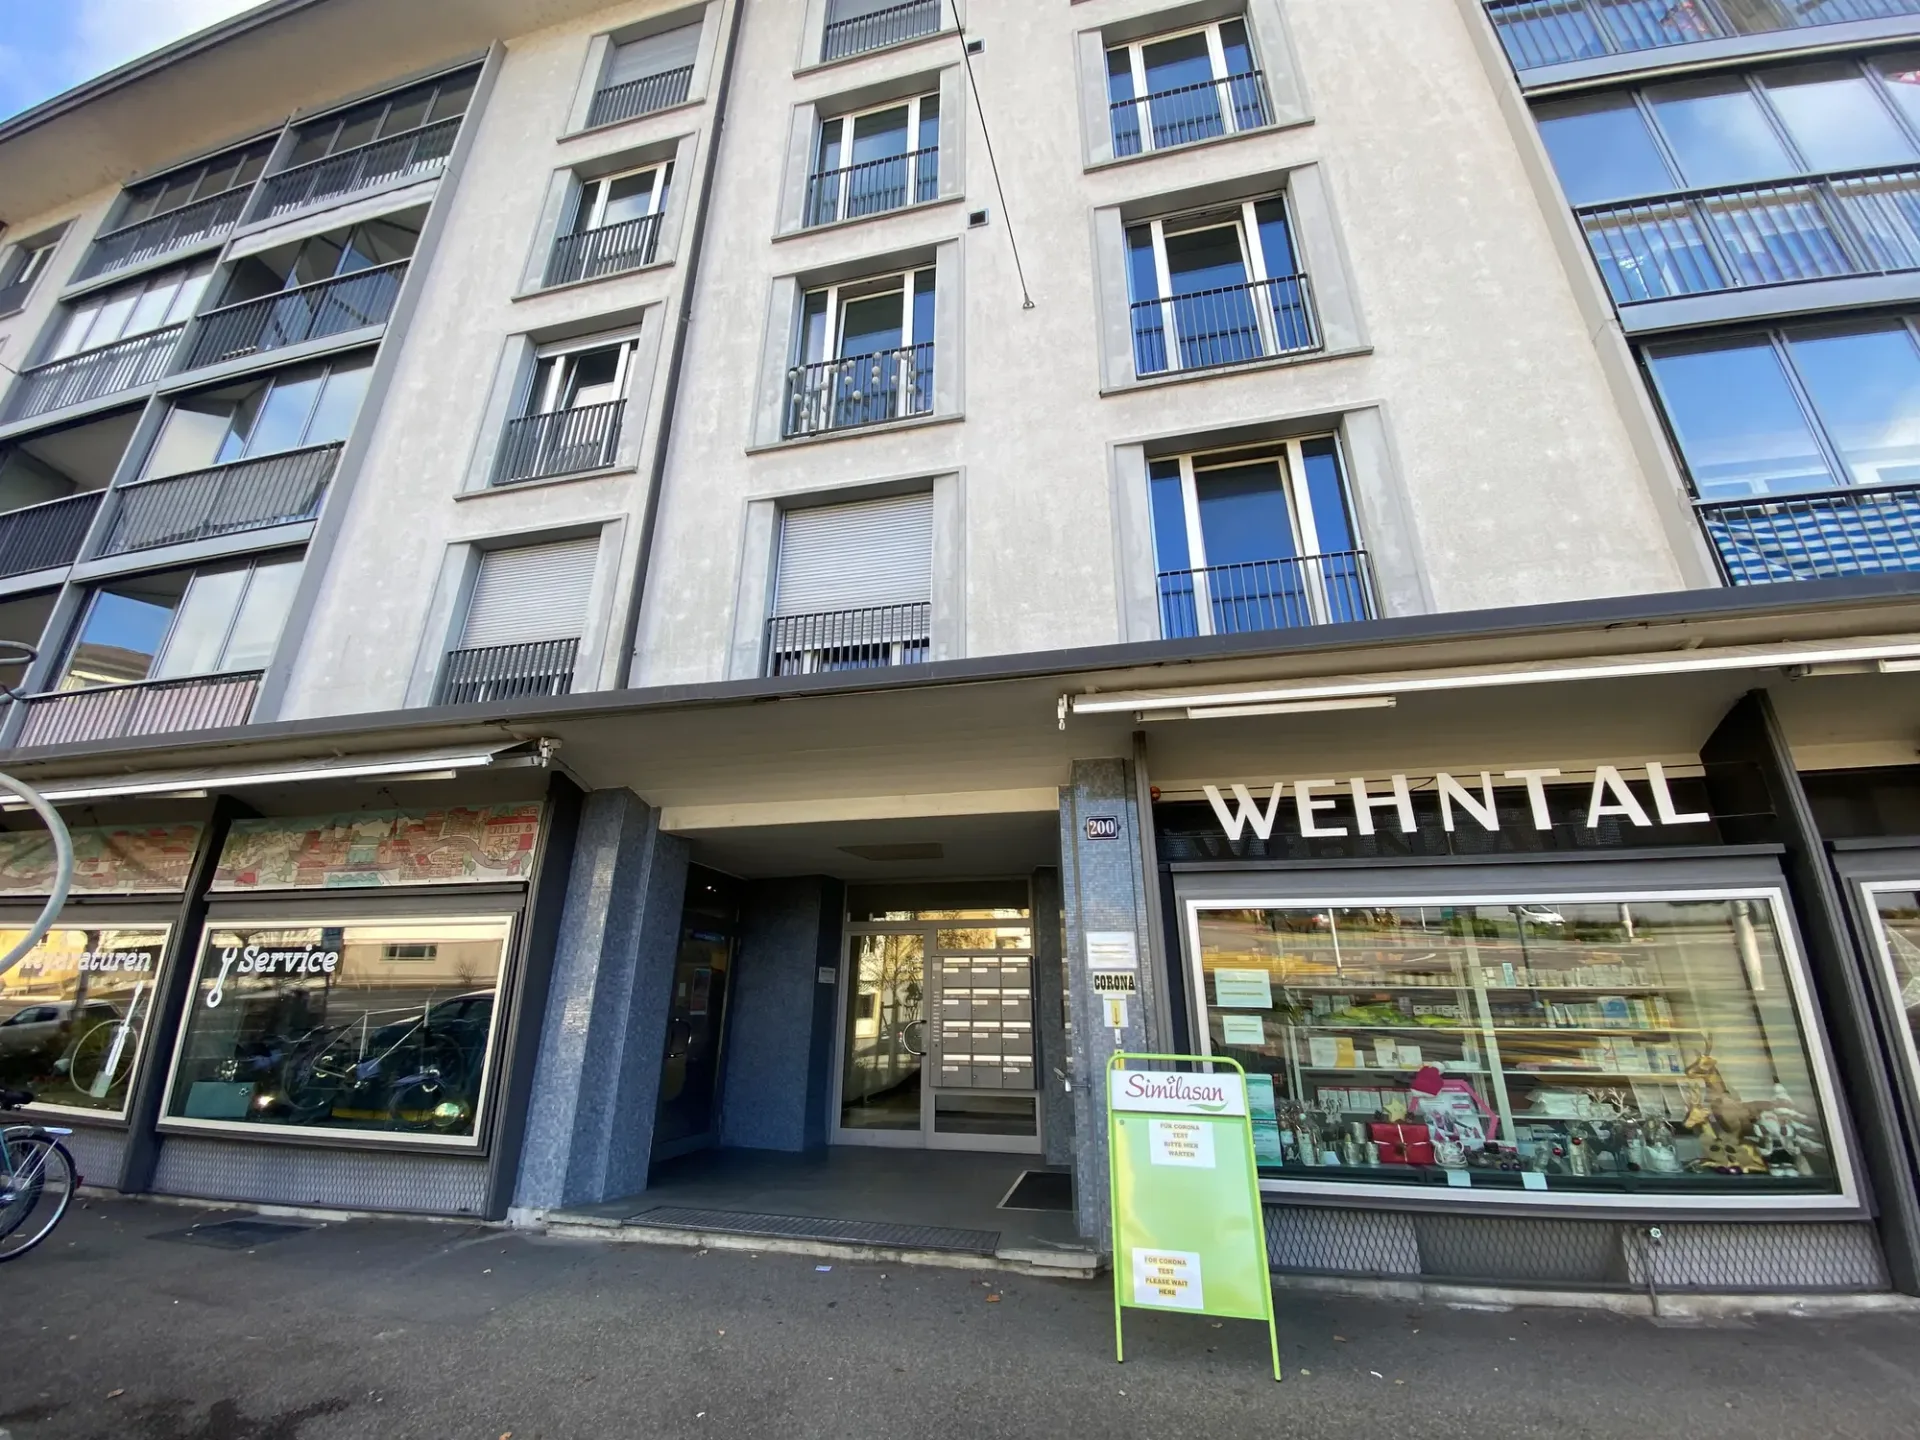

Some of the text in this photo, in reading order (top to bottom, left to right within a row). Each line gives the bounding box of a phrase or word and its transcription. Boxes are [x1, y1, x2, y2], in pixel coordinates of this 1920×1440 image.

[1202, 761, 1710, 841] WEHNTAL
[1089, 819, 1115, 835] 200
[237, 944, 339, 973] Service
[1094, 975, 1136, 991] CORONA
[1124, 1073, 1225, 1102] Similasan
[1173, 1123, 1200, 1131] CORONA
[1163, 1141, 1183, 1149] BITTE
[1167, 1150, 1195, 1158] WARTEN
[1144, 1256, 1187, 1266] FOR CORONA
[1157, 1267, 1174, 1275] TEST
[1145, 1277, 1188, 1288] PLEASE WAIT
[1158, 1288, 1177, 1296] HERE
